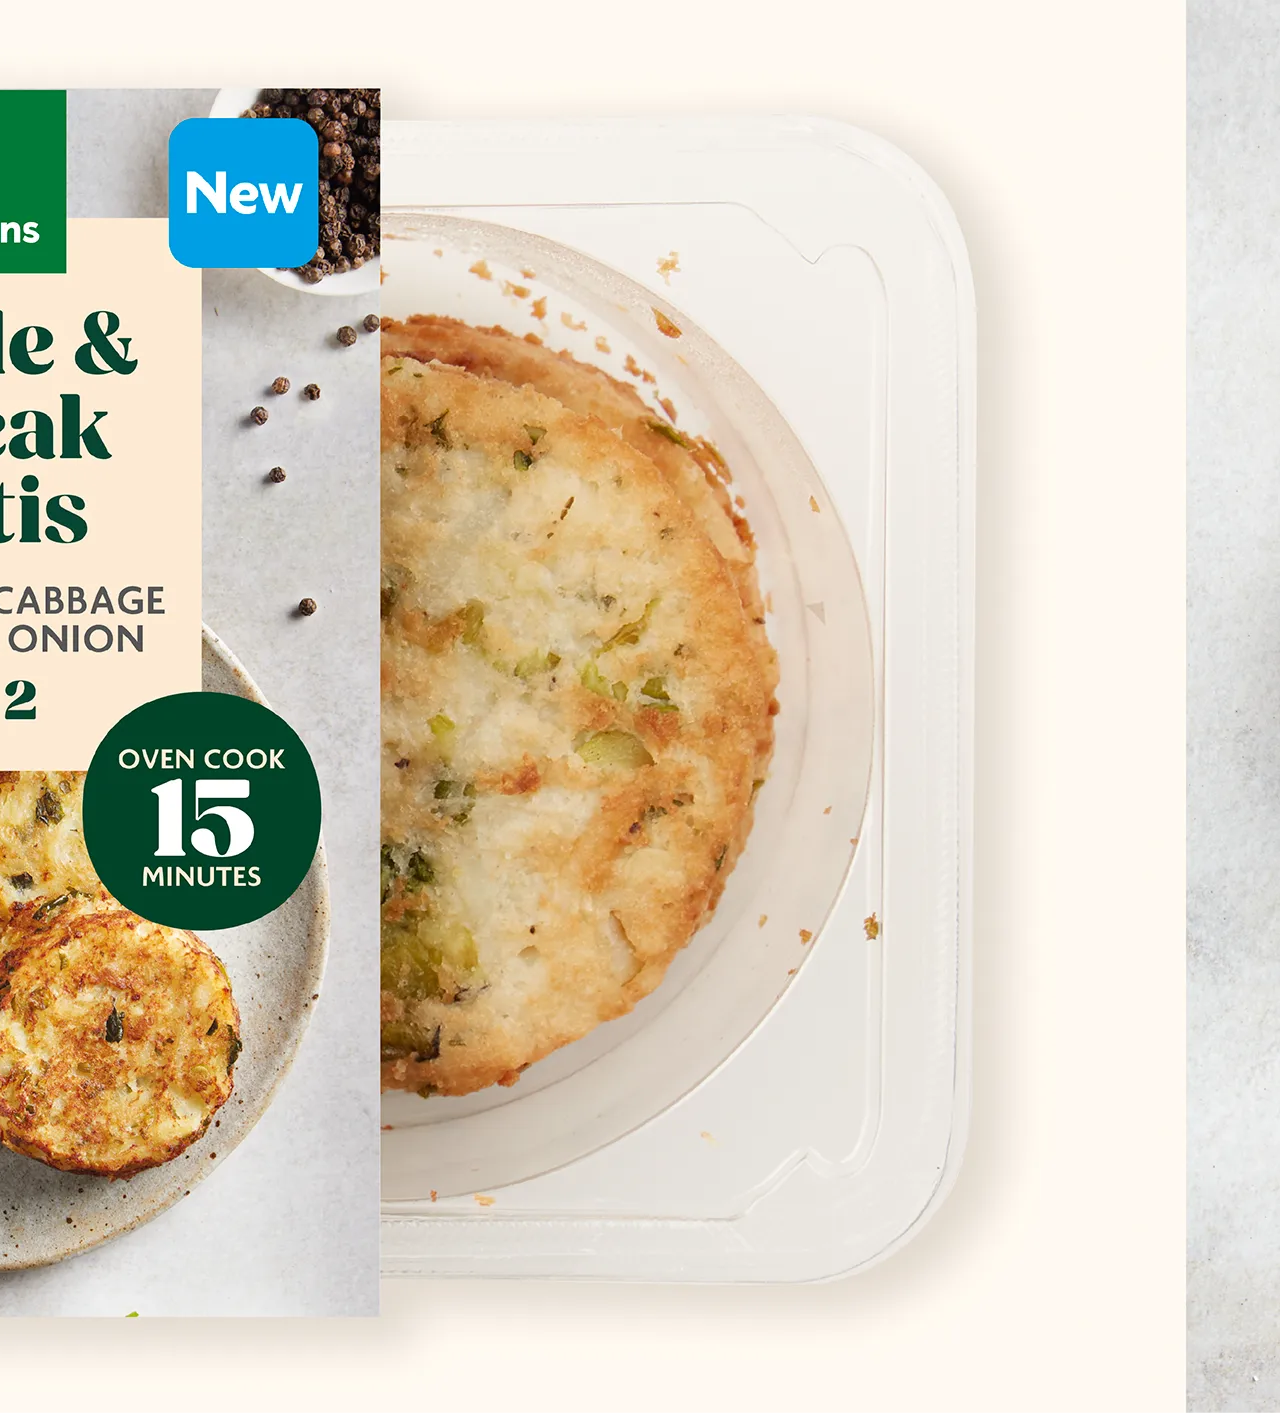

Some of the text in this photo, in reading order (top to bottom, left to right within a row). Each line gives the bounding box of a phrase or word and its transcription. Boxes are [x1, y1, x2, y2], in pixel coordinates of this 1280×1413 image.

[187, 171, 303, 214] New
[75, 311, 138, 375] &
[9, 625, 143, 652] ONION
[5, 680, 36, 719] 2
[119, 749, 285, 769] OVEN COOK
[151, 779, 254, 857] 15
[143, 867, 261, 886] MINUTES
